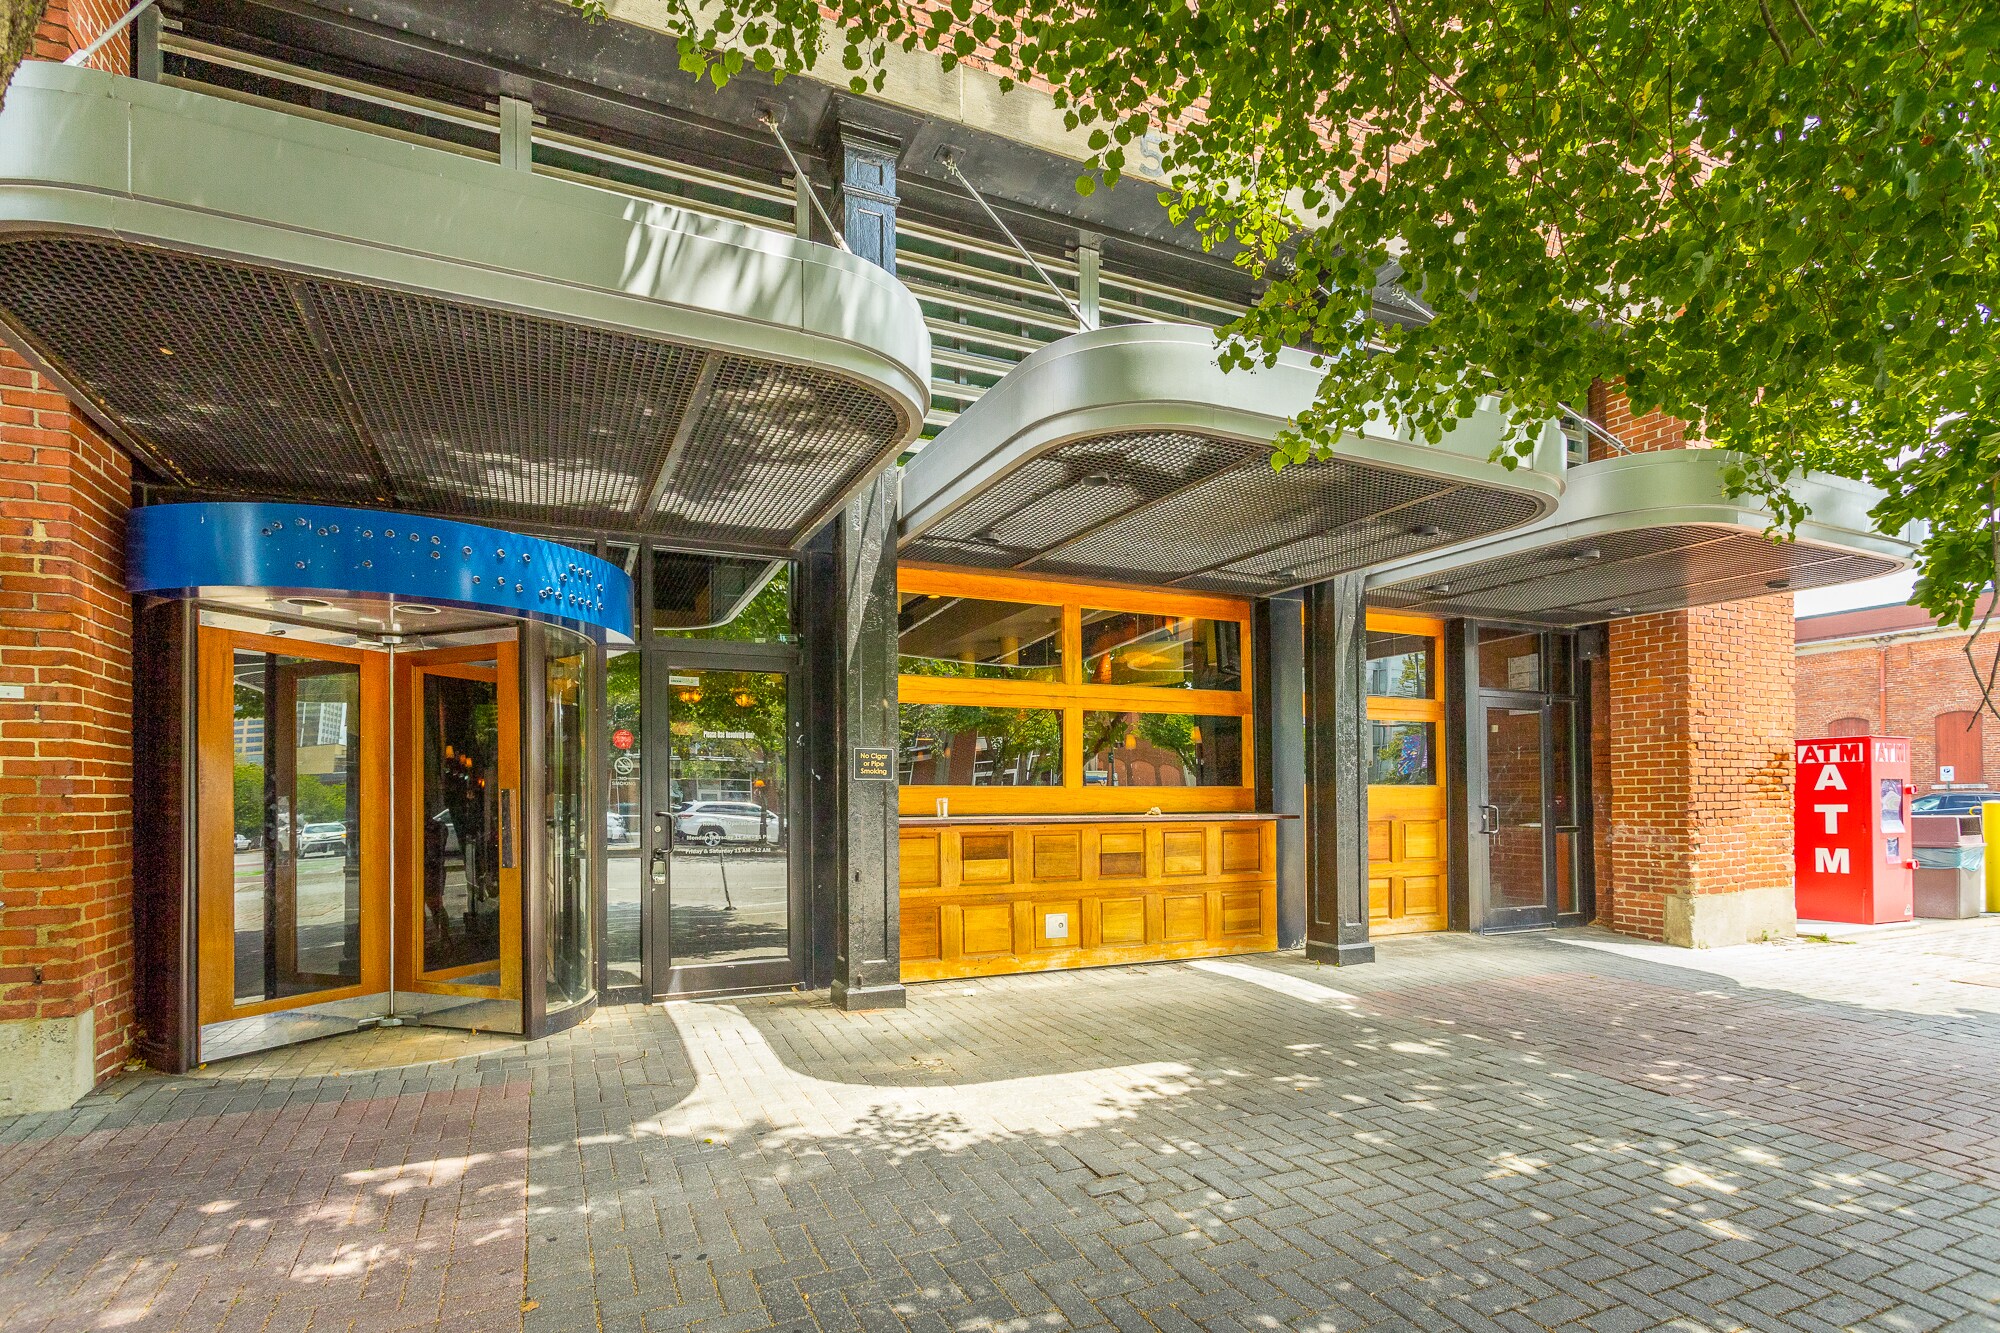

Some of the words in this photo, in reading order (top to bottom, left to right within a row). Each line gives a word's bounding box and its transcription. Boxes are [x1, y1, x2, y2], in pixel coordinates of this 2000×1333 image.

[1139, 132, 1164, 177] 5
[1800, 743, 1861, 763] ATM
[1876, 743, 1906, 762] ATM
